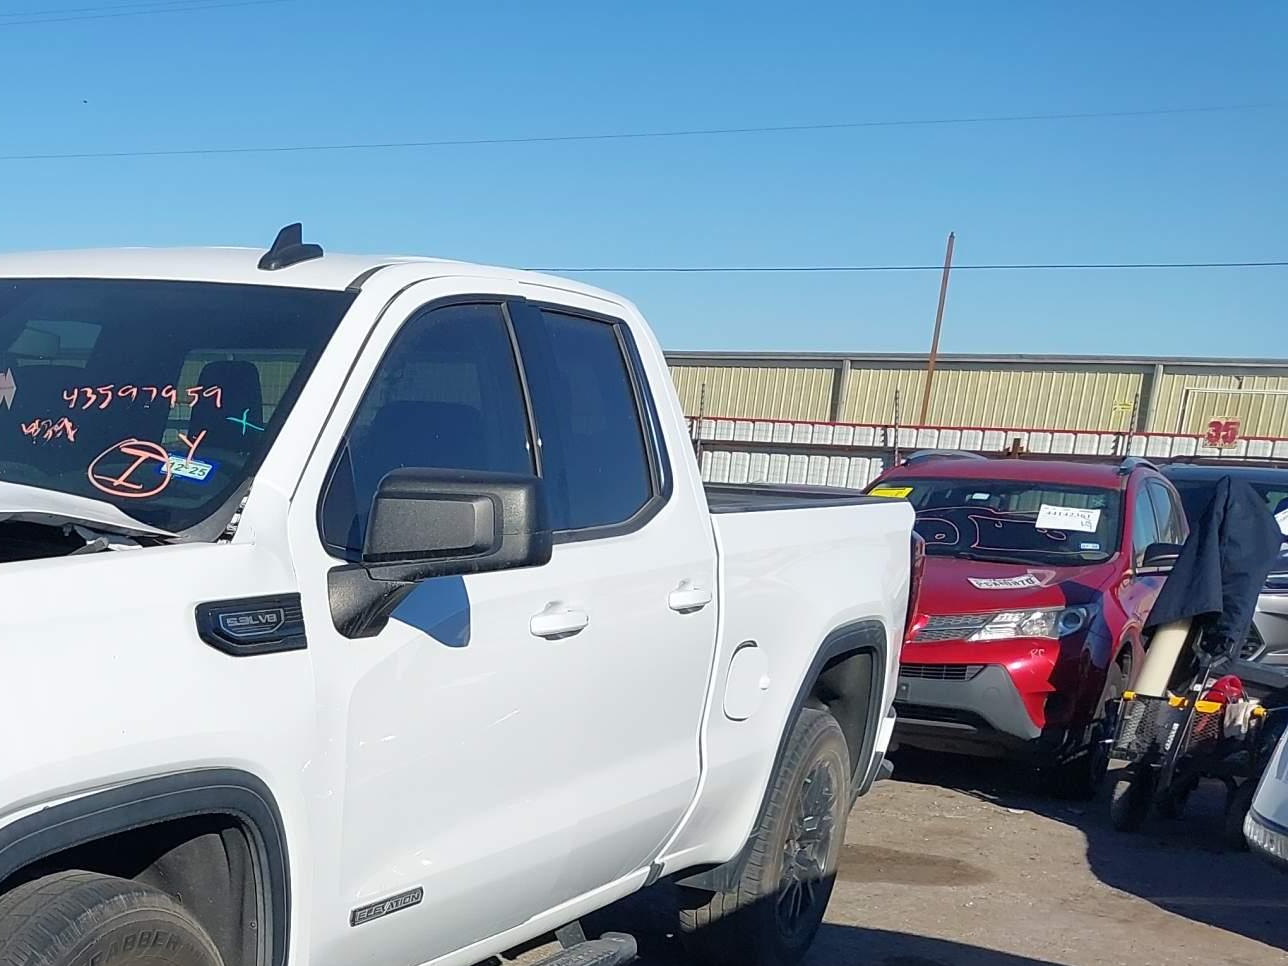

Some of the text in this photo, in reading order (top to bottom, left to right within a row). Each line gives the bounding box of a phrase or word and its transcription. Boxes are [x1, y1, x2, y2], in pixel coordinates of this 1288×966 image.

[63, 384, 224, 410] 43597959
[1207, 420, 1241, 444] 35
[357, 892, 420, 921] ELEVATION
